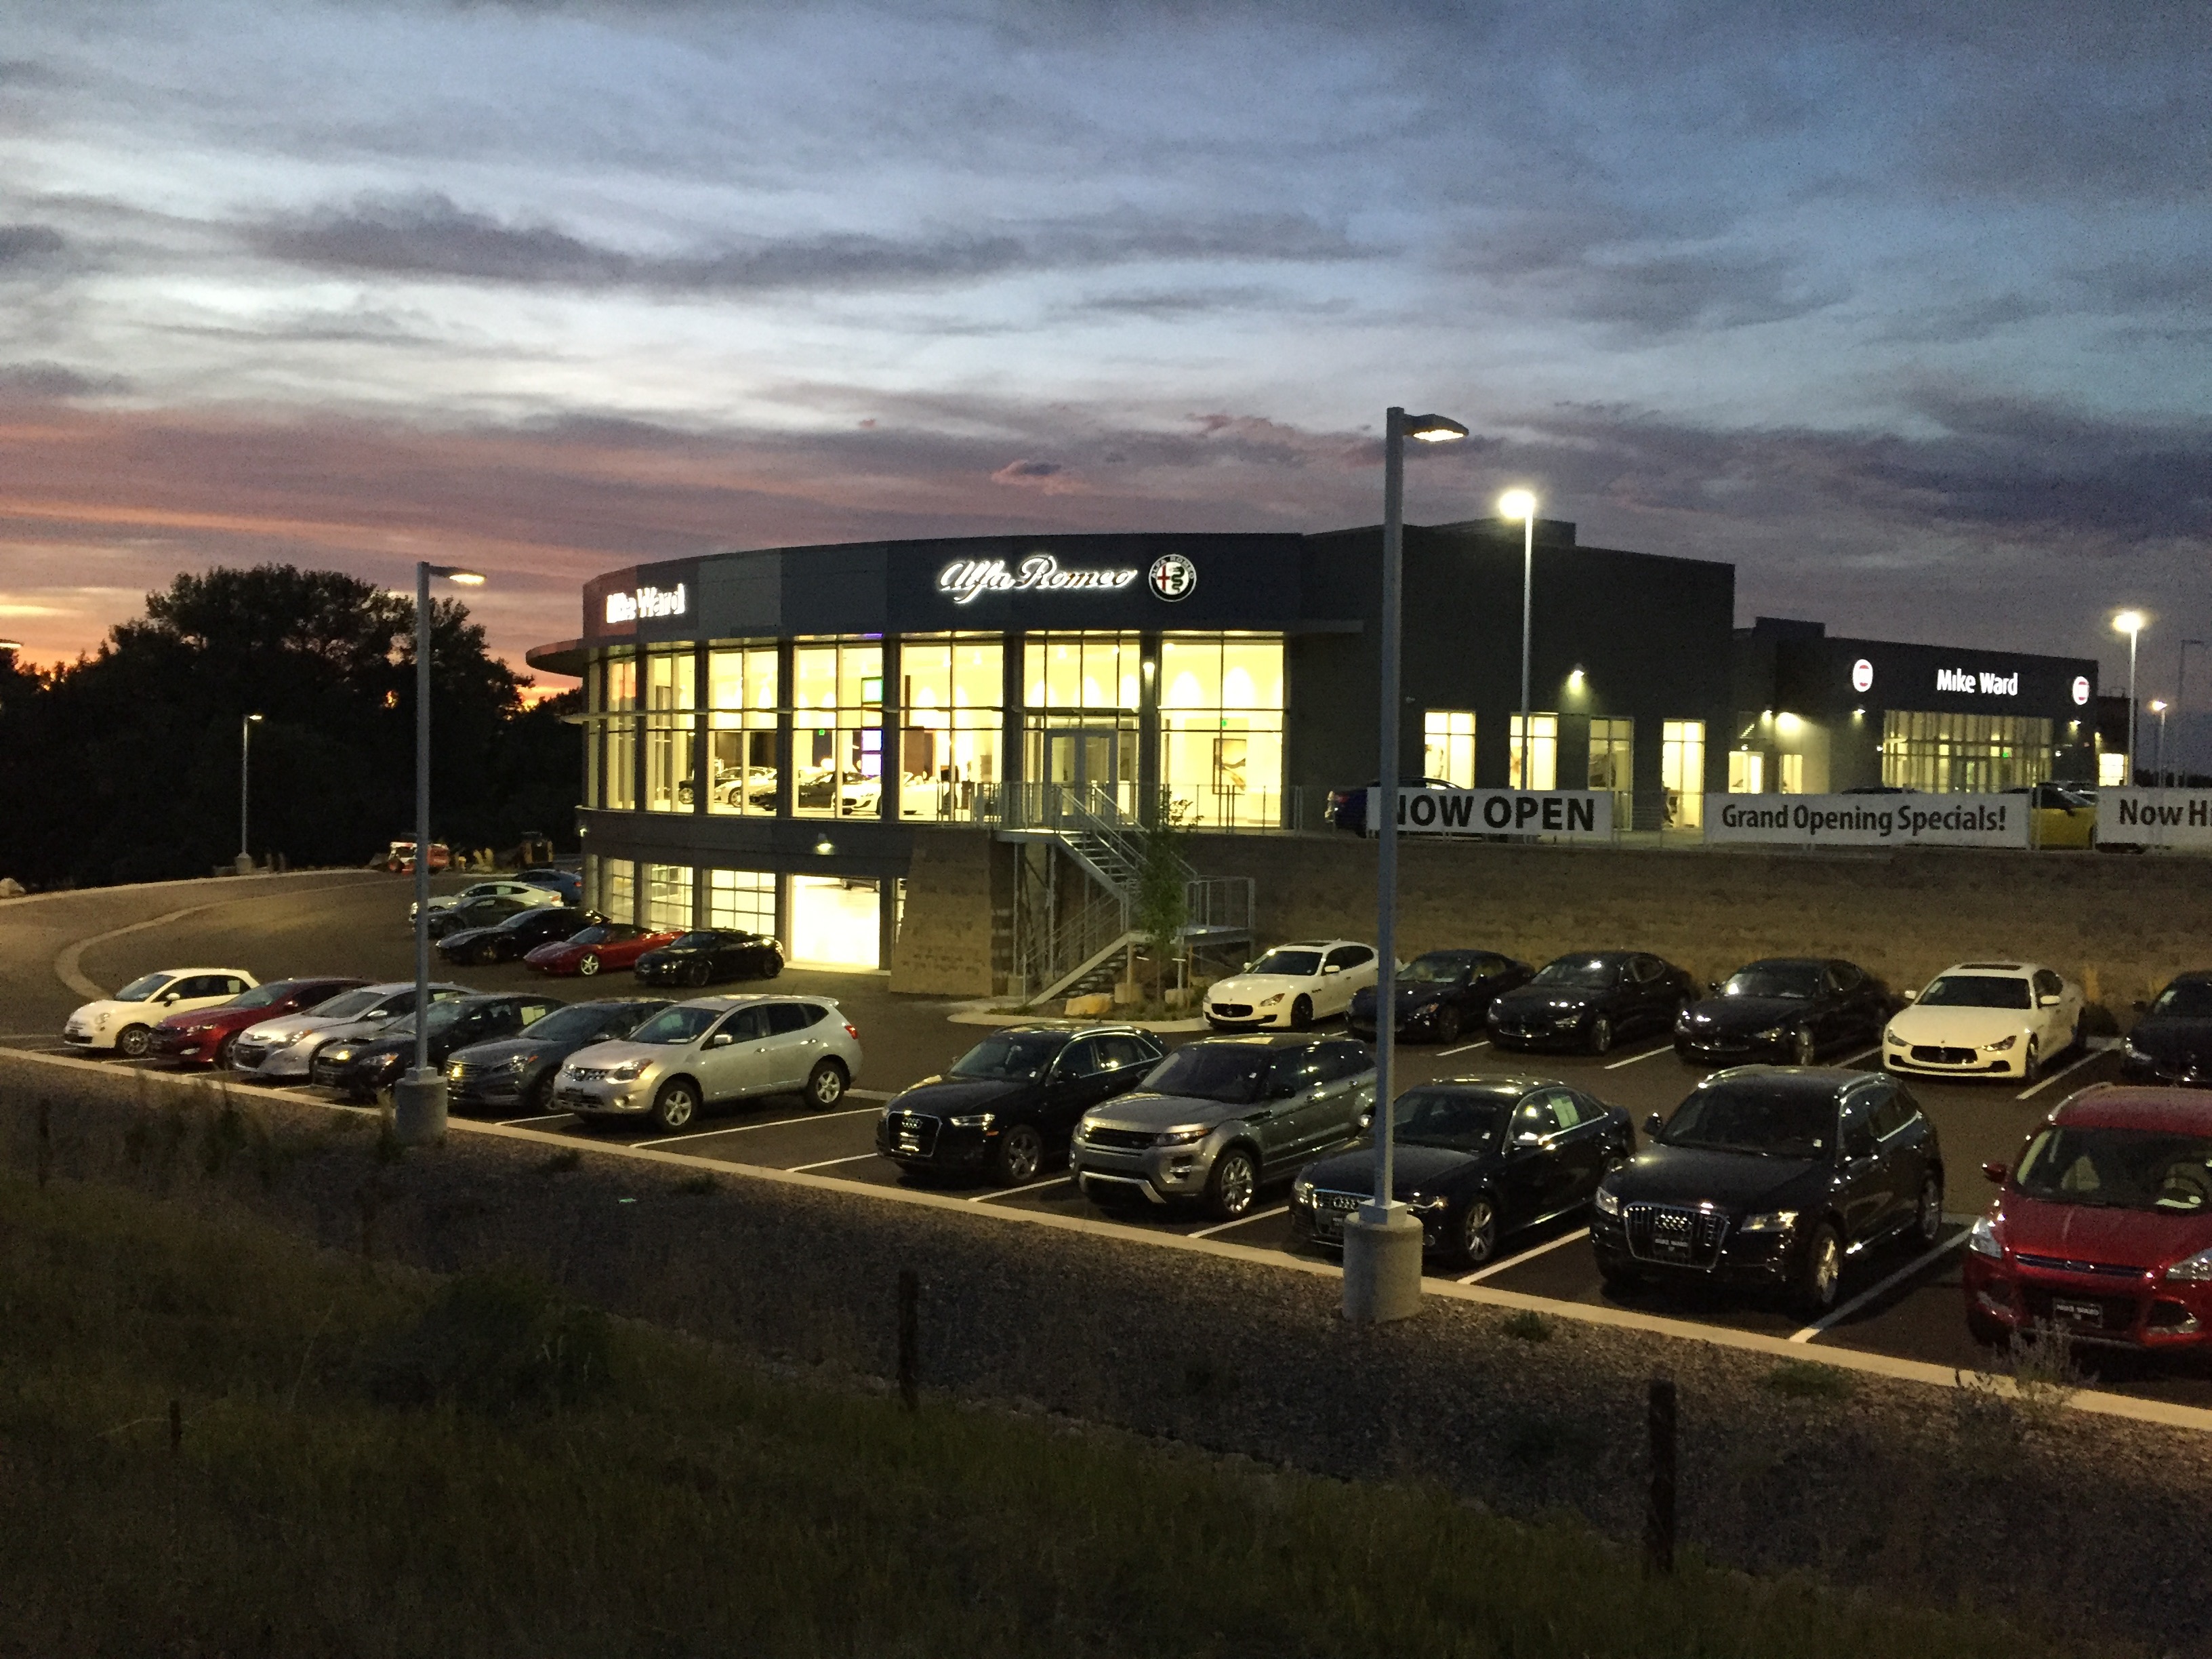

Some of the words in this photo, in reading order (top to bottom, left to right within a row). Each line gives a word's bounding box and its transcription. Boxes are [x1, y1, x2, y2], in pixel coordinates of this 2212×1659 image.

[940, 560, 1017, 604] Alfa
[1015, 555, 1138, 589] Romeo
[636, 583, 685, 618] Ward
[1937, 668, 1976, 693] Mike
[1980, 672, 2018, 696] Ward
[1483, 796, 1595, 832] OPEN
[1722, 804, 1788, 828] Grand
[1793, 804, 1893, 837] Opening
[1898, 804, 2007, 836] Specials!
[2119, 798, 2184, 826] Now
